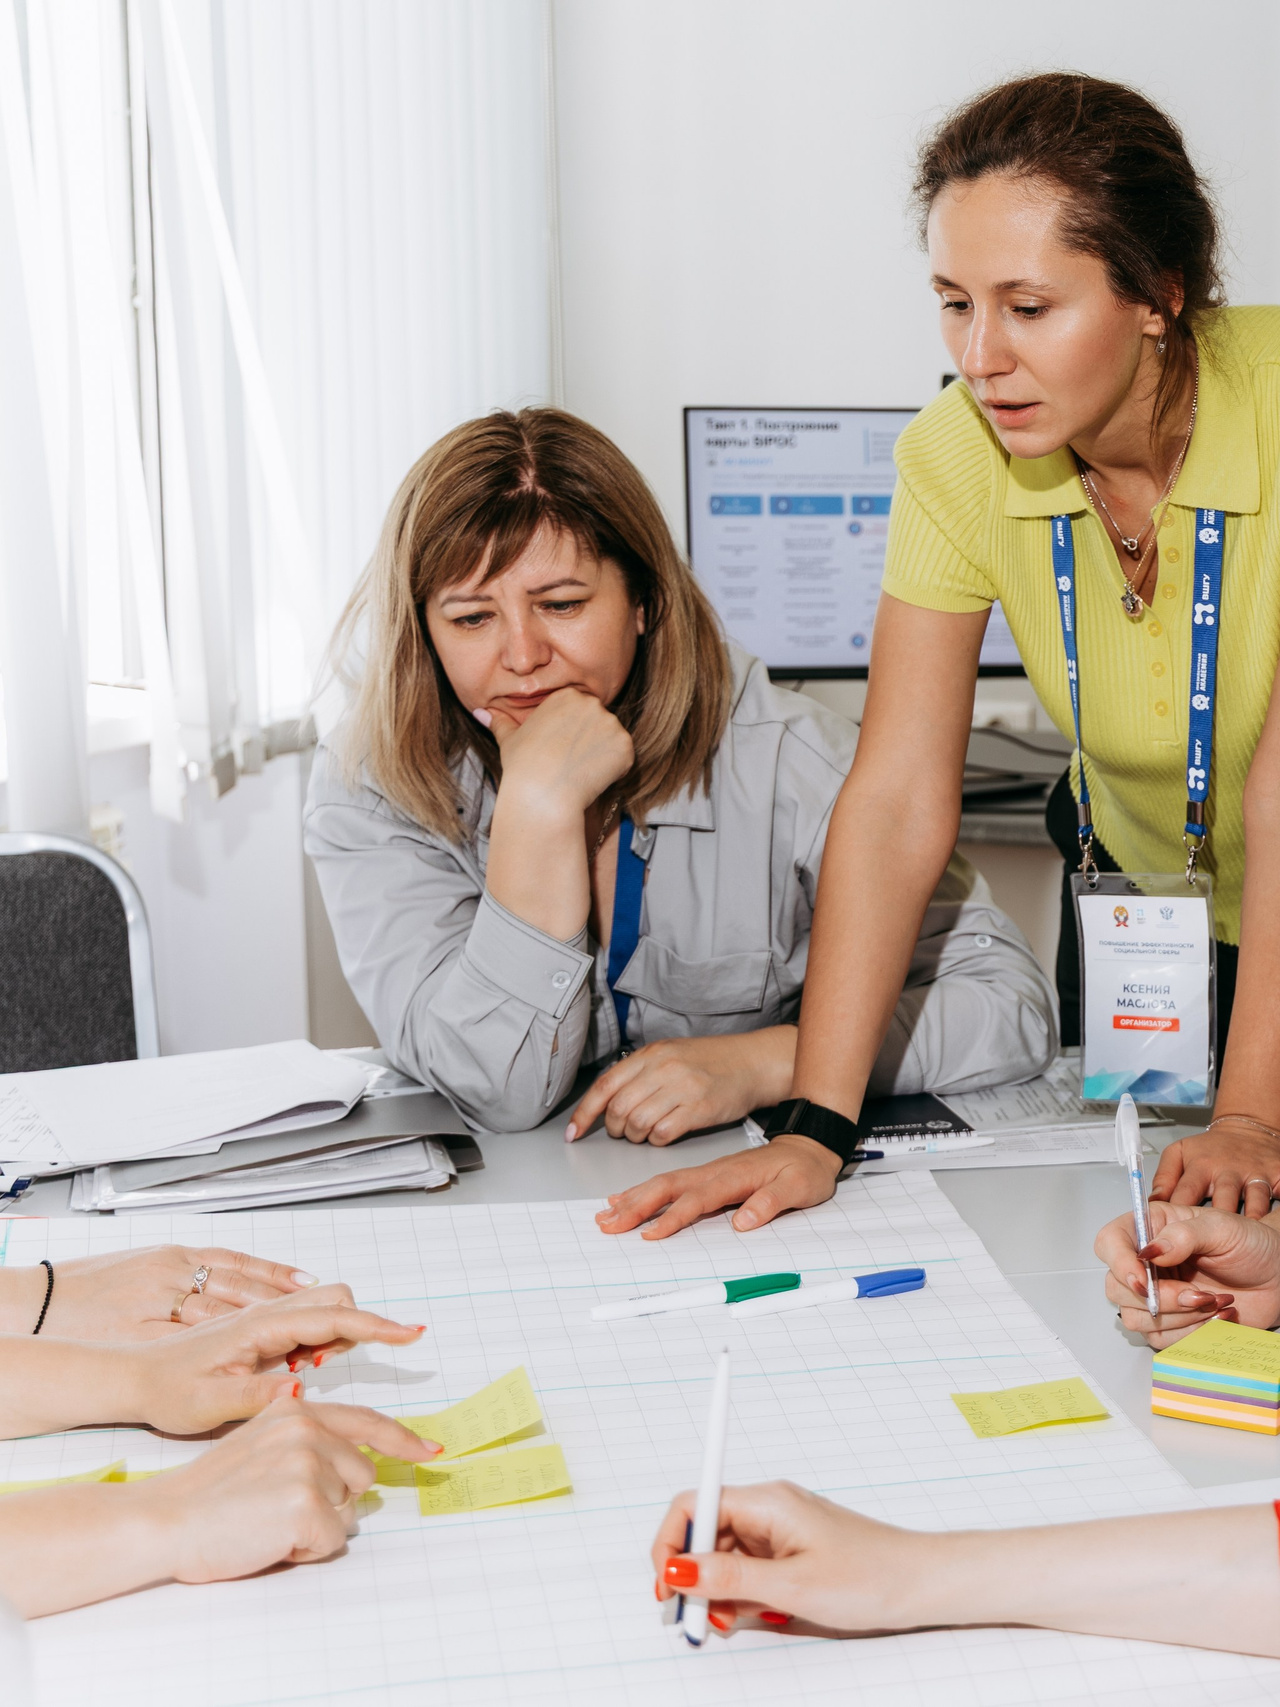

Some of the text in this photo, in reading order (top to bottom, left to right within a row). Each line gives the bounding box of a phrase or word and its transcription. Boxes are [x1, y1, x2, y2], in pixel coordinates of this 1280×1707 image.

[1056, 521, 1065, 547] ВШГУ
[1201, 573, 1211, 600] ВШГУ
[1200, 653, 1208, 692] АКАДЕМИЯ
[1194, 739, 1202, 765] ВШГУ
[1141, 941, 1195, 949] ЭФФЕКТИВНОСТИ
[1123, 983, 1170, 995] КСЕНИЯ
[1119, 1018, 1172, 1027] ОРГАНИЗАТОР
